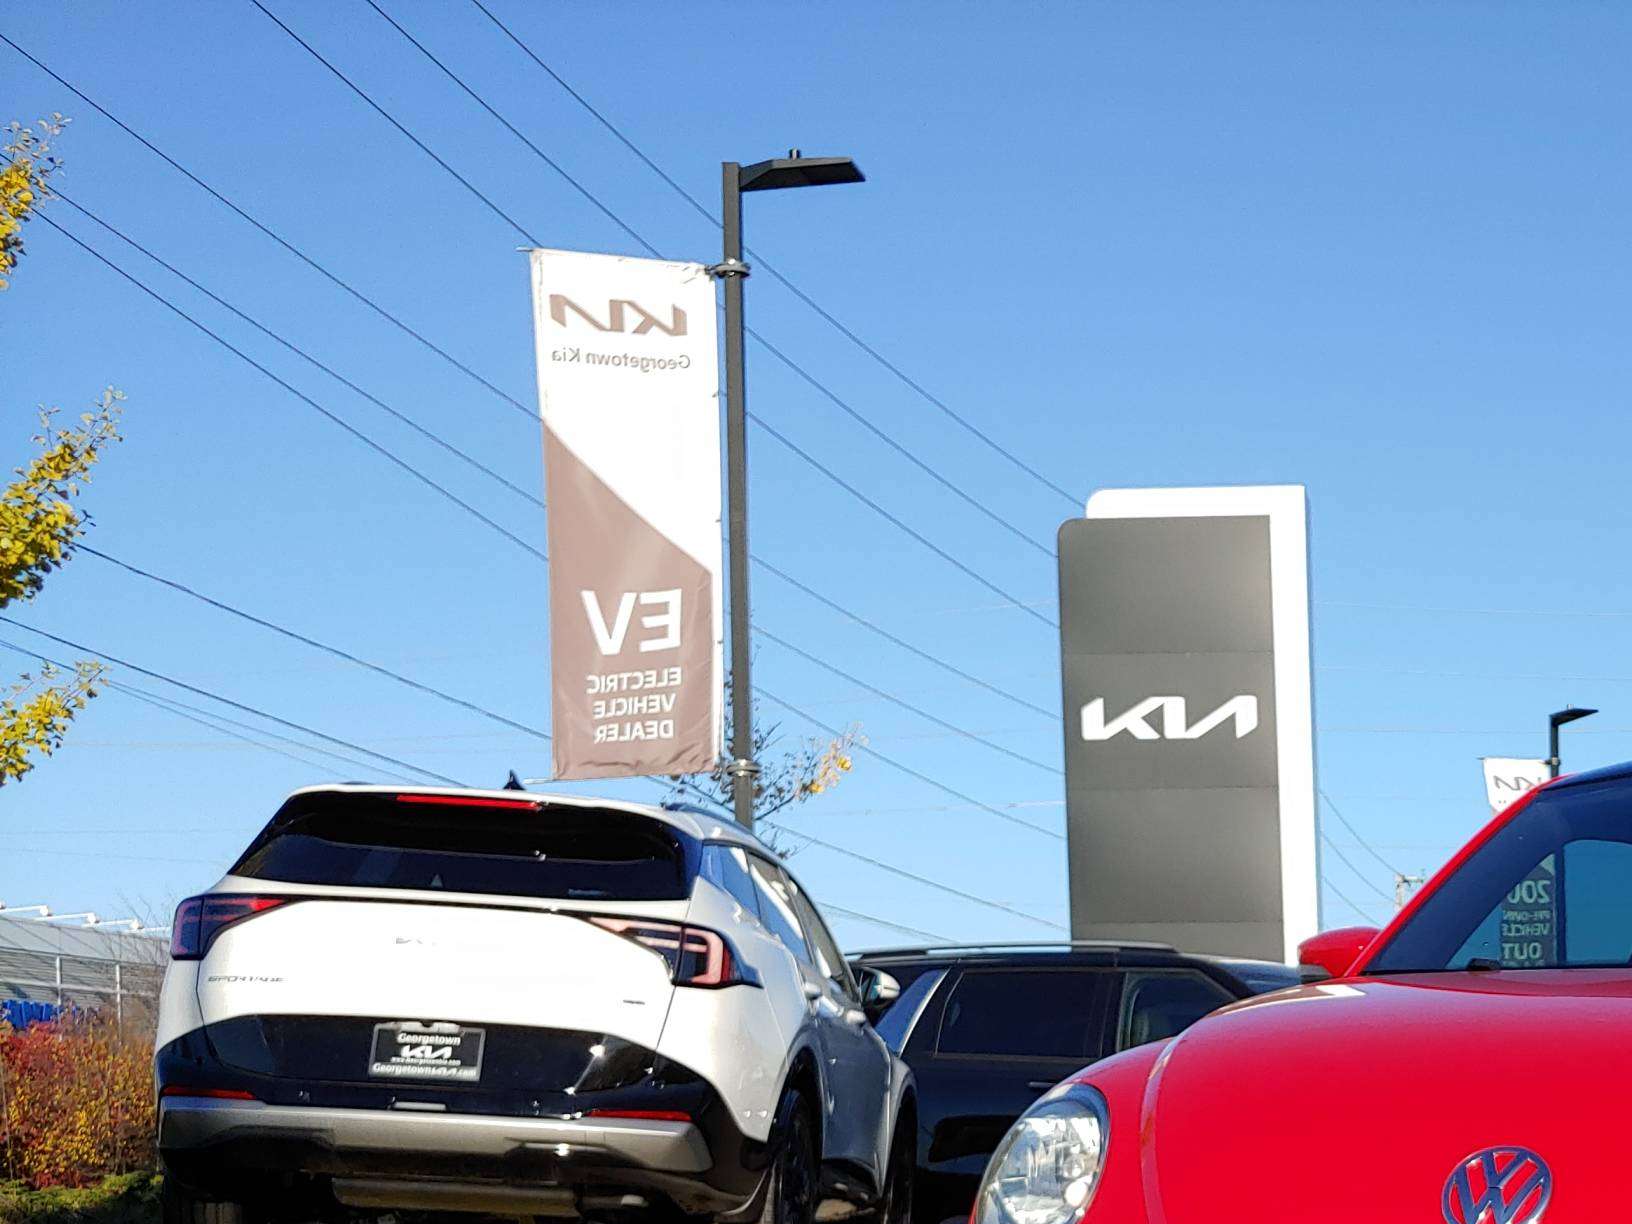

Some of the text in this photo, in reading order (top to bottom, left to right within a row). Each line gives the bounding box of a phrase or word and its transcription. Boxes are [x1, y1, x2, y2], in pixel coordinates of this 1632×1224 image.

[1080, 695, 1259, 741] KIA
[396, 1032, 461, 1046] Georgetown
[401, 1045, 453, 1059] KIA
